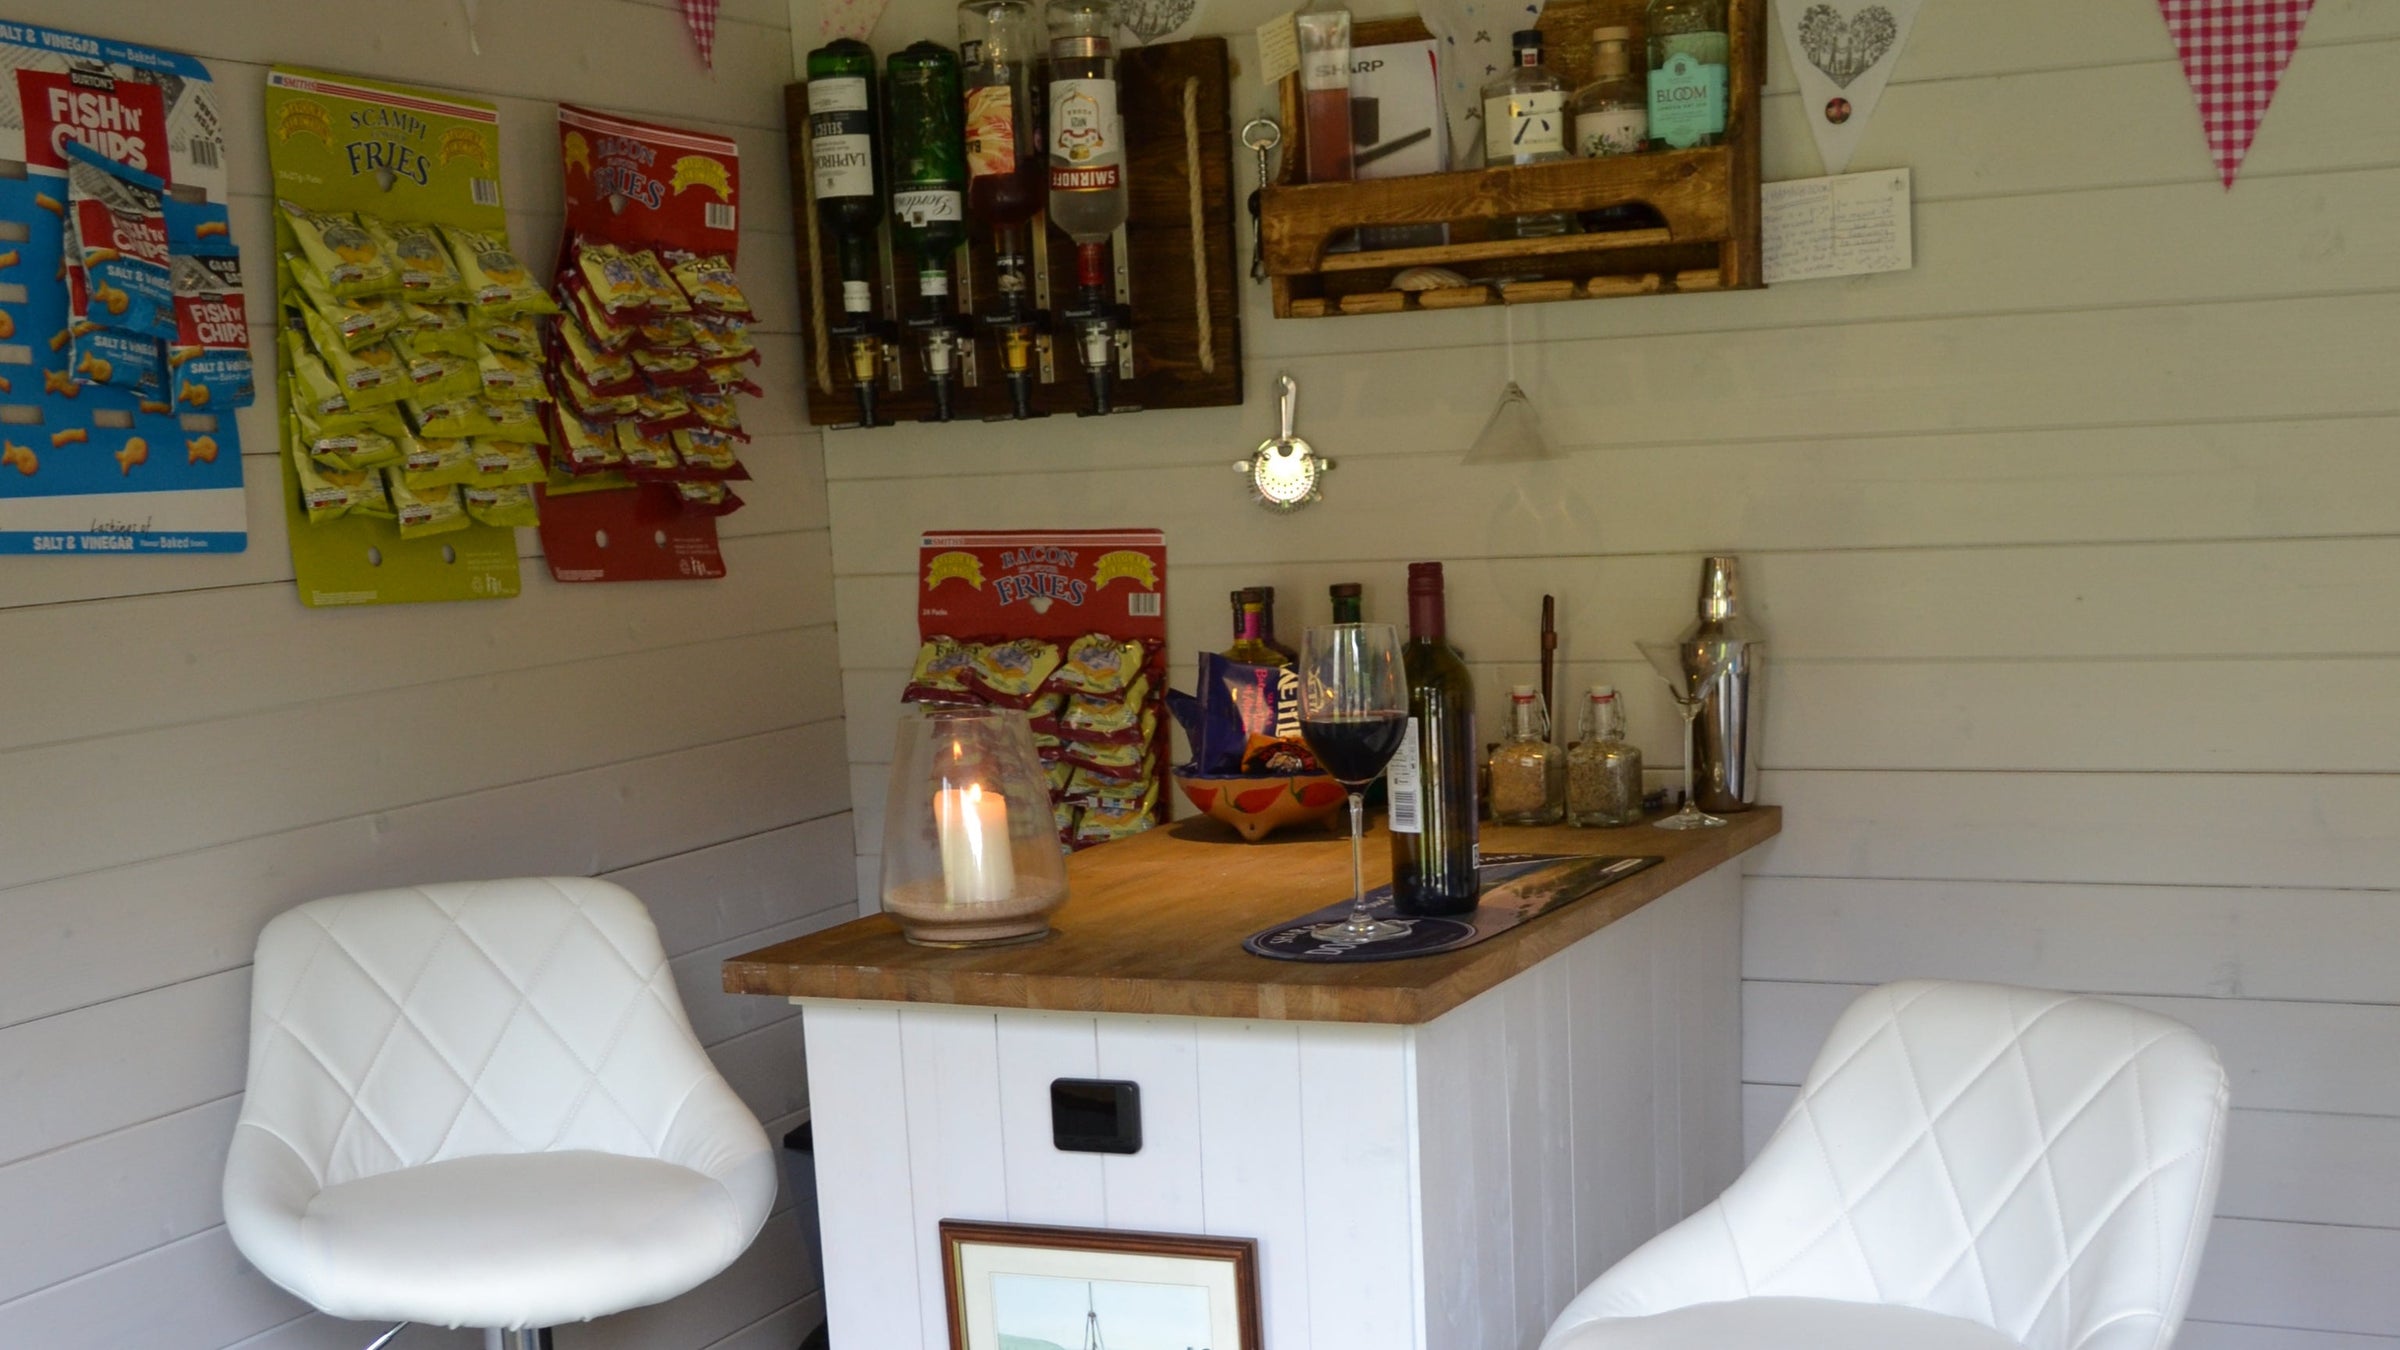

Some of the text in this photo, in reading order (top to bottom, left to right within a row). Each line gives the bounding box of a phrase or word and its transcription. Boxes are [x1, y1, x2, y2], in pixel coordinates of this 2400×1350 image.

[0, 24, 23, 42] ALT
[25, 28, 36, 43] &
[41, 31, 100, 55] VINEGAR
[72, 72, 115, 90] BURTON'S
[1655, 85, 1708, 103] BLOOM
[48, 87, 121, 131] FISH
[349, 107, 428, 141] SCAMPI
[51, 123, 148, 172] CHIPS
[345, 139, 432, 188] FRIES
[813, 152, 866, 169] LAPHRO
[593, 166, 667, 210] FRIES
[1051, 169, 1116, 187] SMIRNOFF
[189, 303, 231, 323] FISH
[197, 322, 247, 343] CHIPS
[33, 536, 63, 551] SALT
[66, 535, 76, 550] &
[80, 536, 134, 551] VINEGAR
[160, 536, 189, 549] Baked
[1000, 546, 1079, 569] BACON
[993, 572, 1088, 607] FRIES
